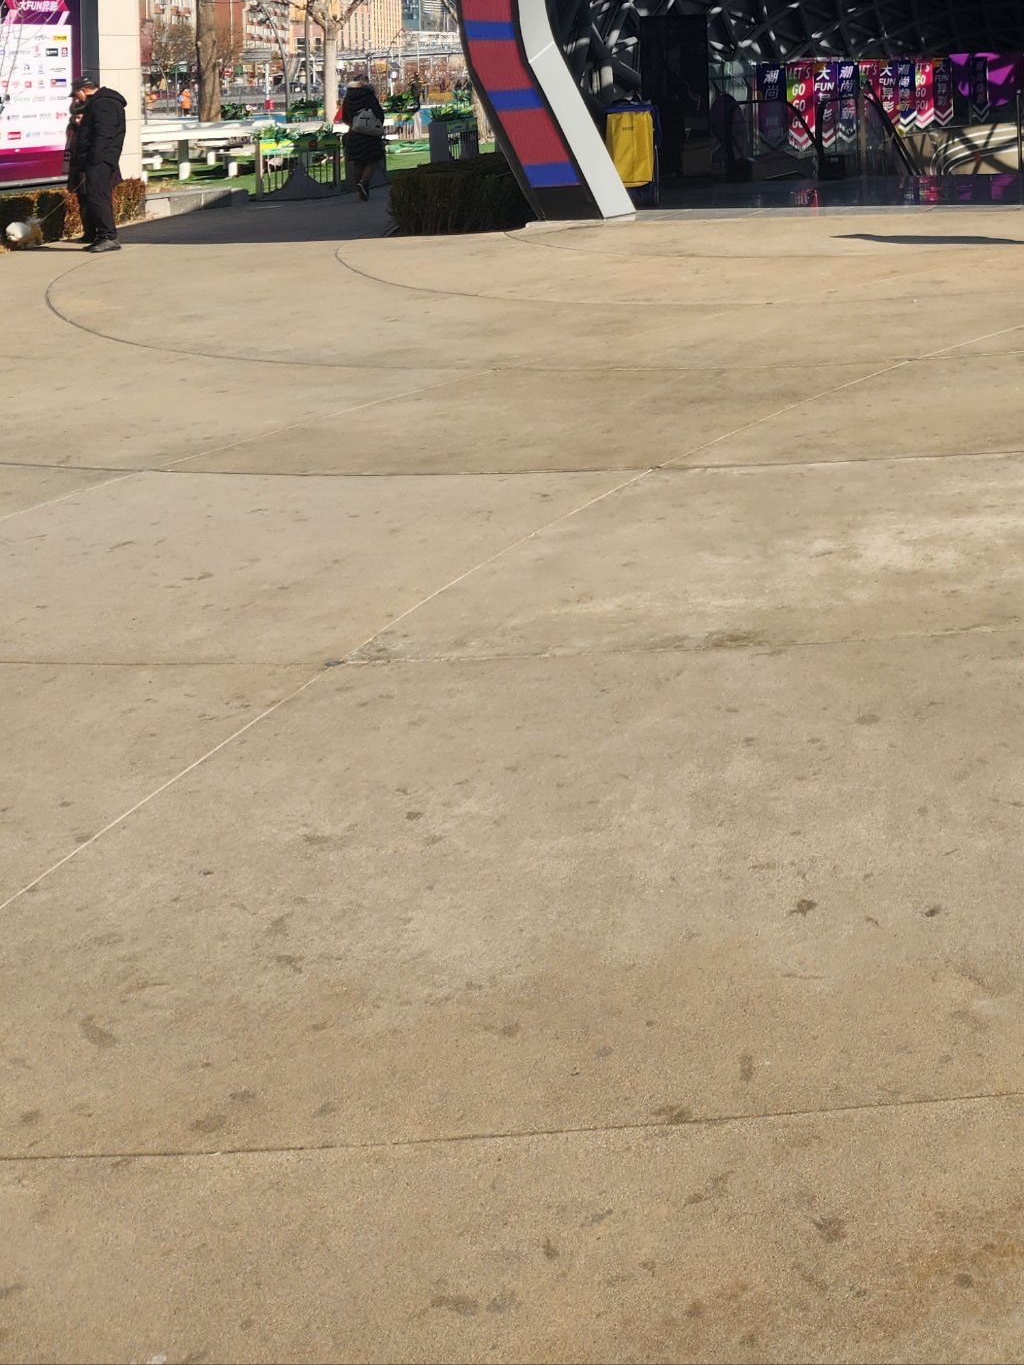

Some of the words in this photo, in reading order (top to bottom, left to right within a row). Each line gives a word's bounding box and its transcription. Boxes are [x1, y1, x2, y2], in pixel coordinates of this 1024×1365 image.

[915, 75, 927, 86] GO
[791, 83, 806, 96] GO
[915, 87, 927, 98] GO
